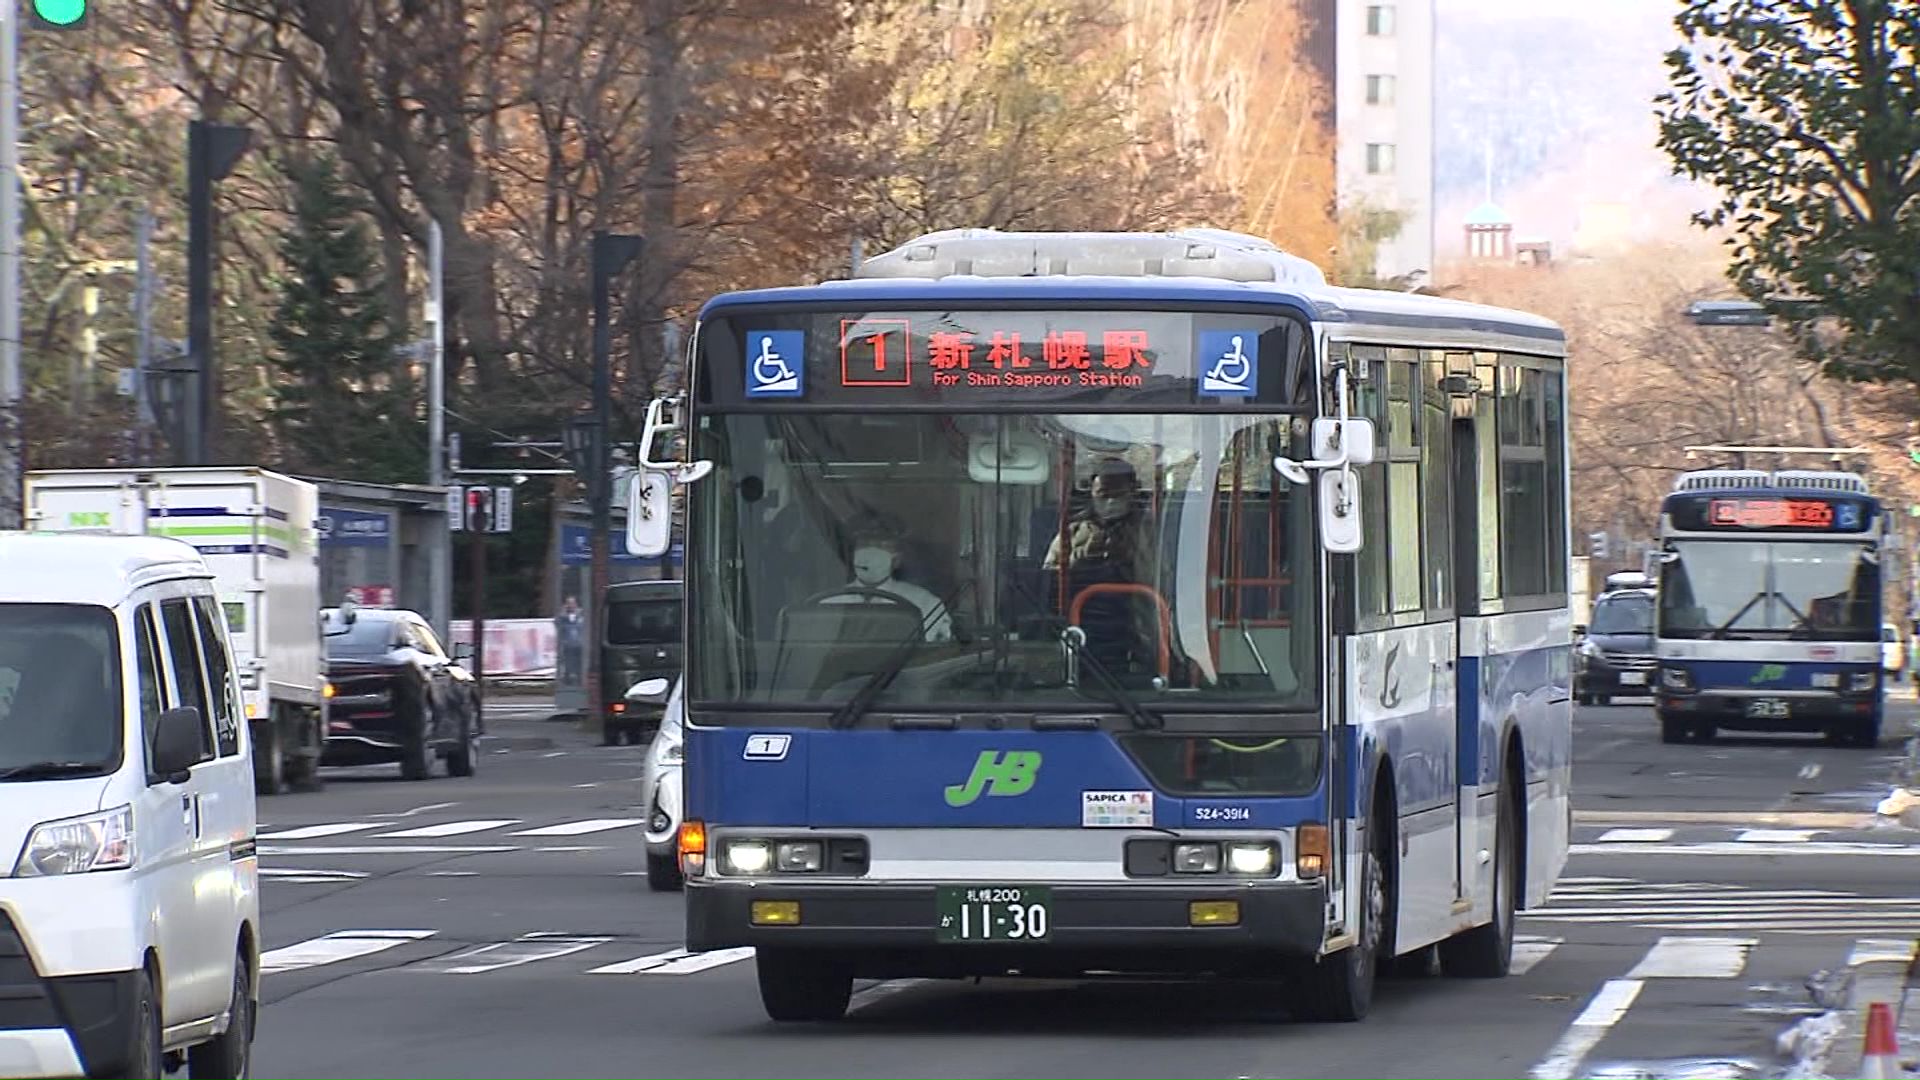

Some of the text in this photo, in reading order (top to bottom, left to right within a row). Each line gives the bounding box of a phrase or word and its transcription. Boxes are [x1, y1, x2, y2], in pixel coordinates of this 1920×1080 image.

[867, 333, 886, 371] 1
[929, 330, 1150, 370] 新札幌駅
[934, 372, 1143, 387] For Shin Sapporo Station
[763, 740, 771, 751] 1
[945, 750, 1042, 806] JHB
[1086, 794, 1126, 802] SAPICA
[1196, 808, 1249, 819] 524-3914
[961, 904, 1046, 938] 11-30
